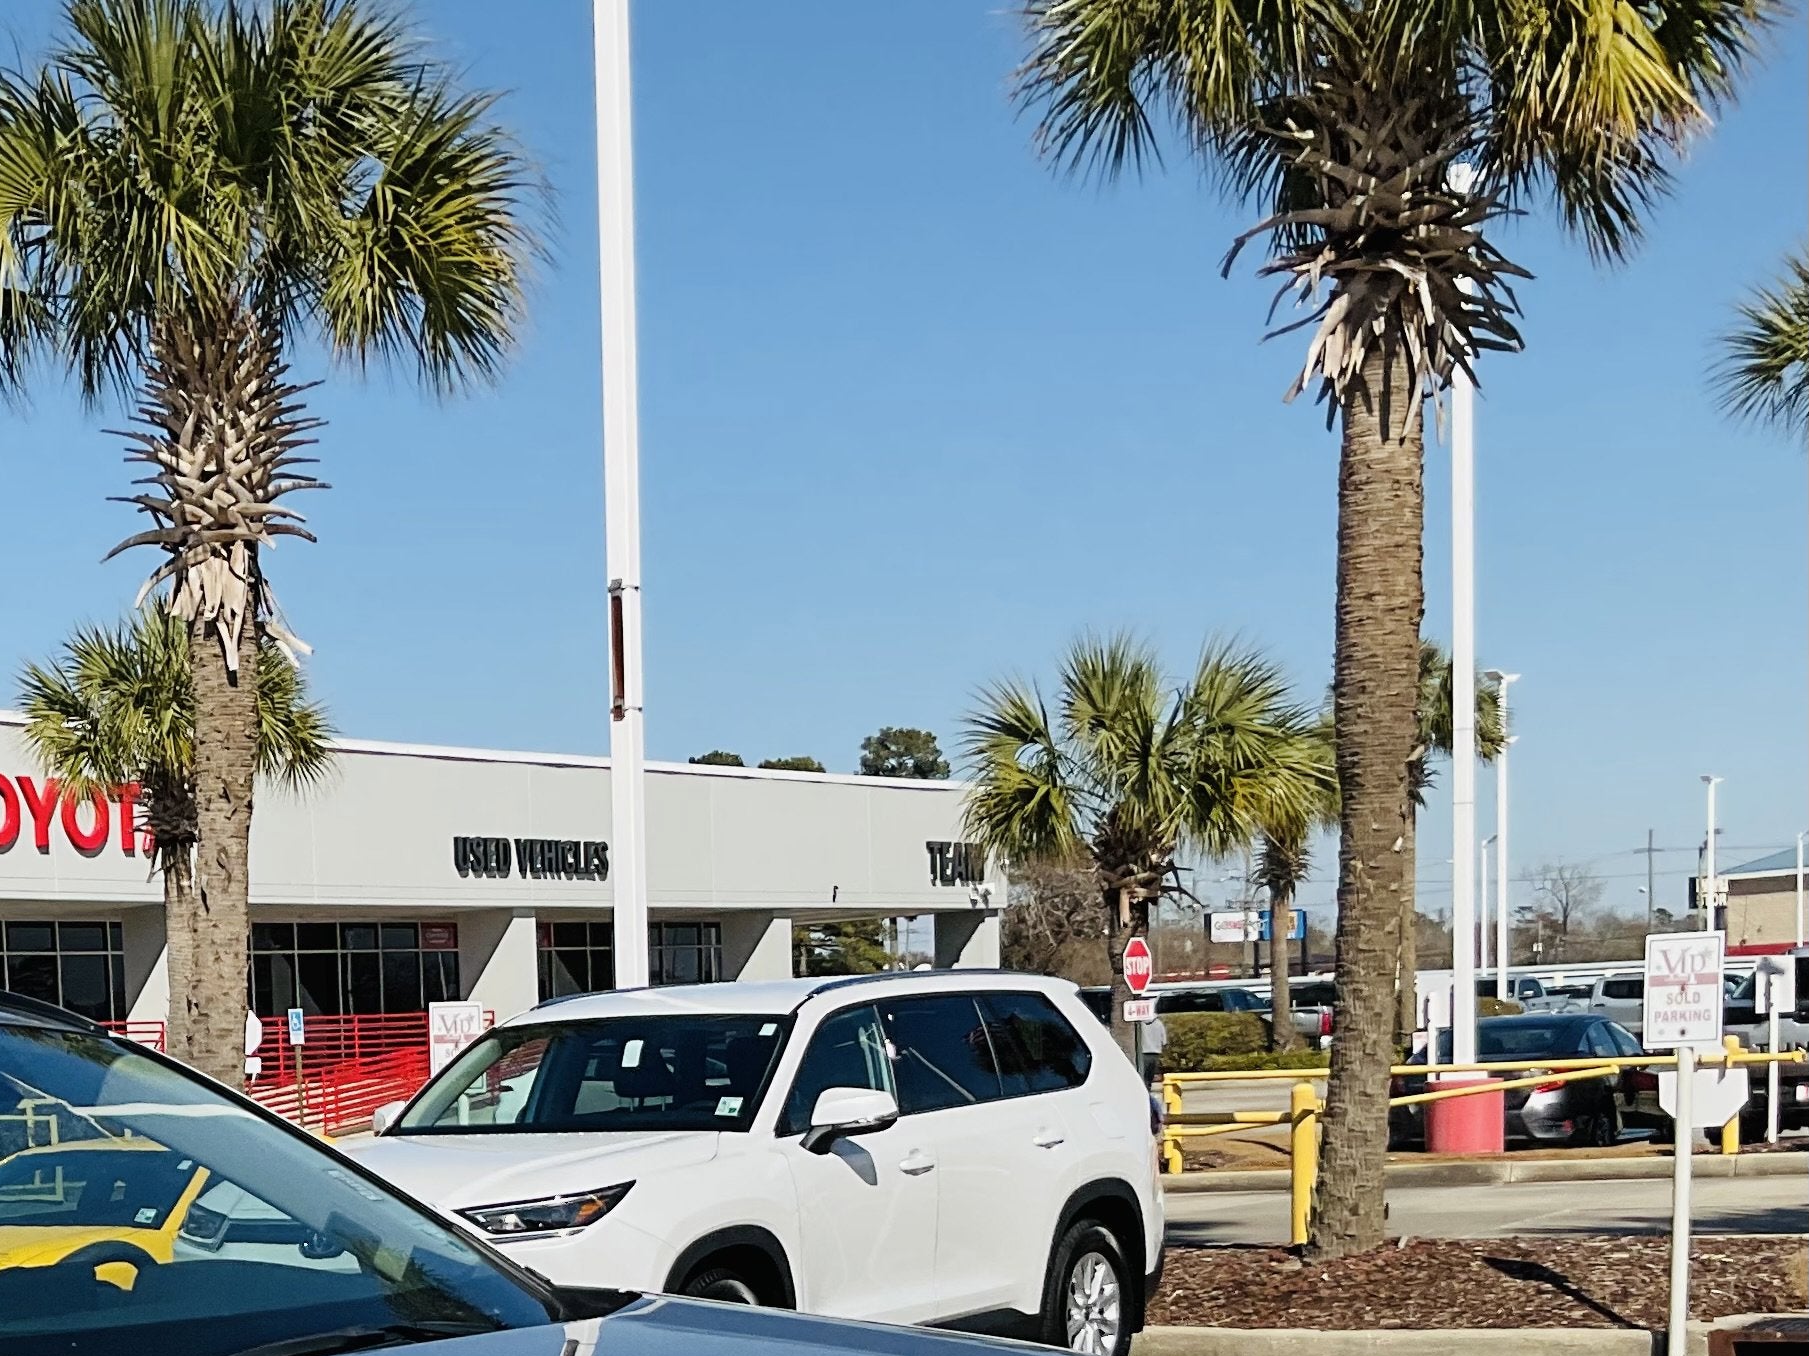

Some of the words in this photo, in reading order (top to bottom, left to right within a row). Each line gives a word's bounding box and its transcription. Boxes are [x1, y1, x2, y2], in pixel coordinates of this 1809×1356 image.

[453, 837, 511, 876] USED
[514, 839, 609, 879] VEHICLES
[1125, 956, 1150, 976] STOP
[1666, 992, 1701, 1005] SOLD
[1654, 1010, 1712, 1023] PARKING
